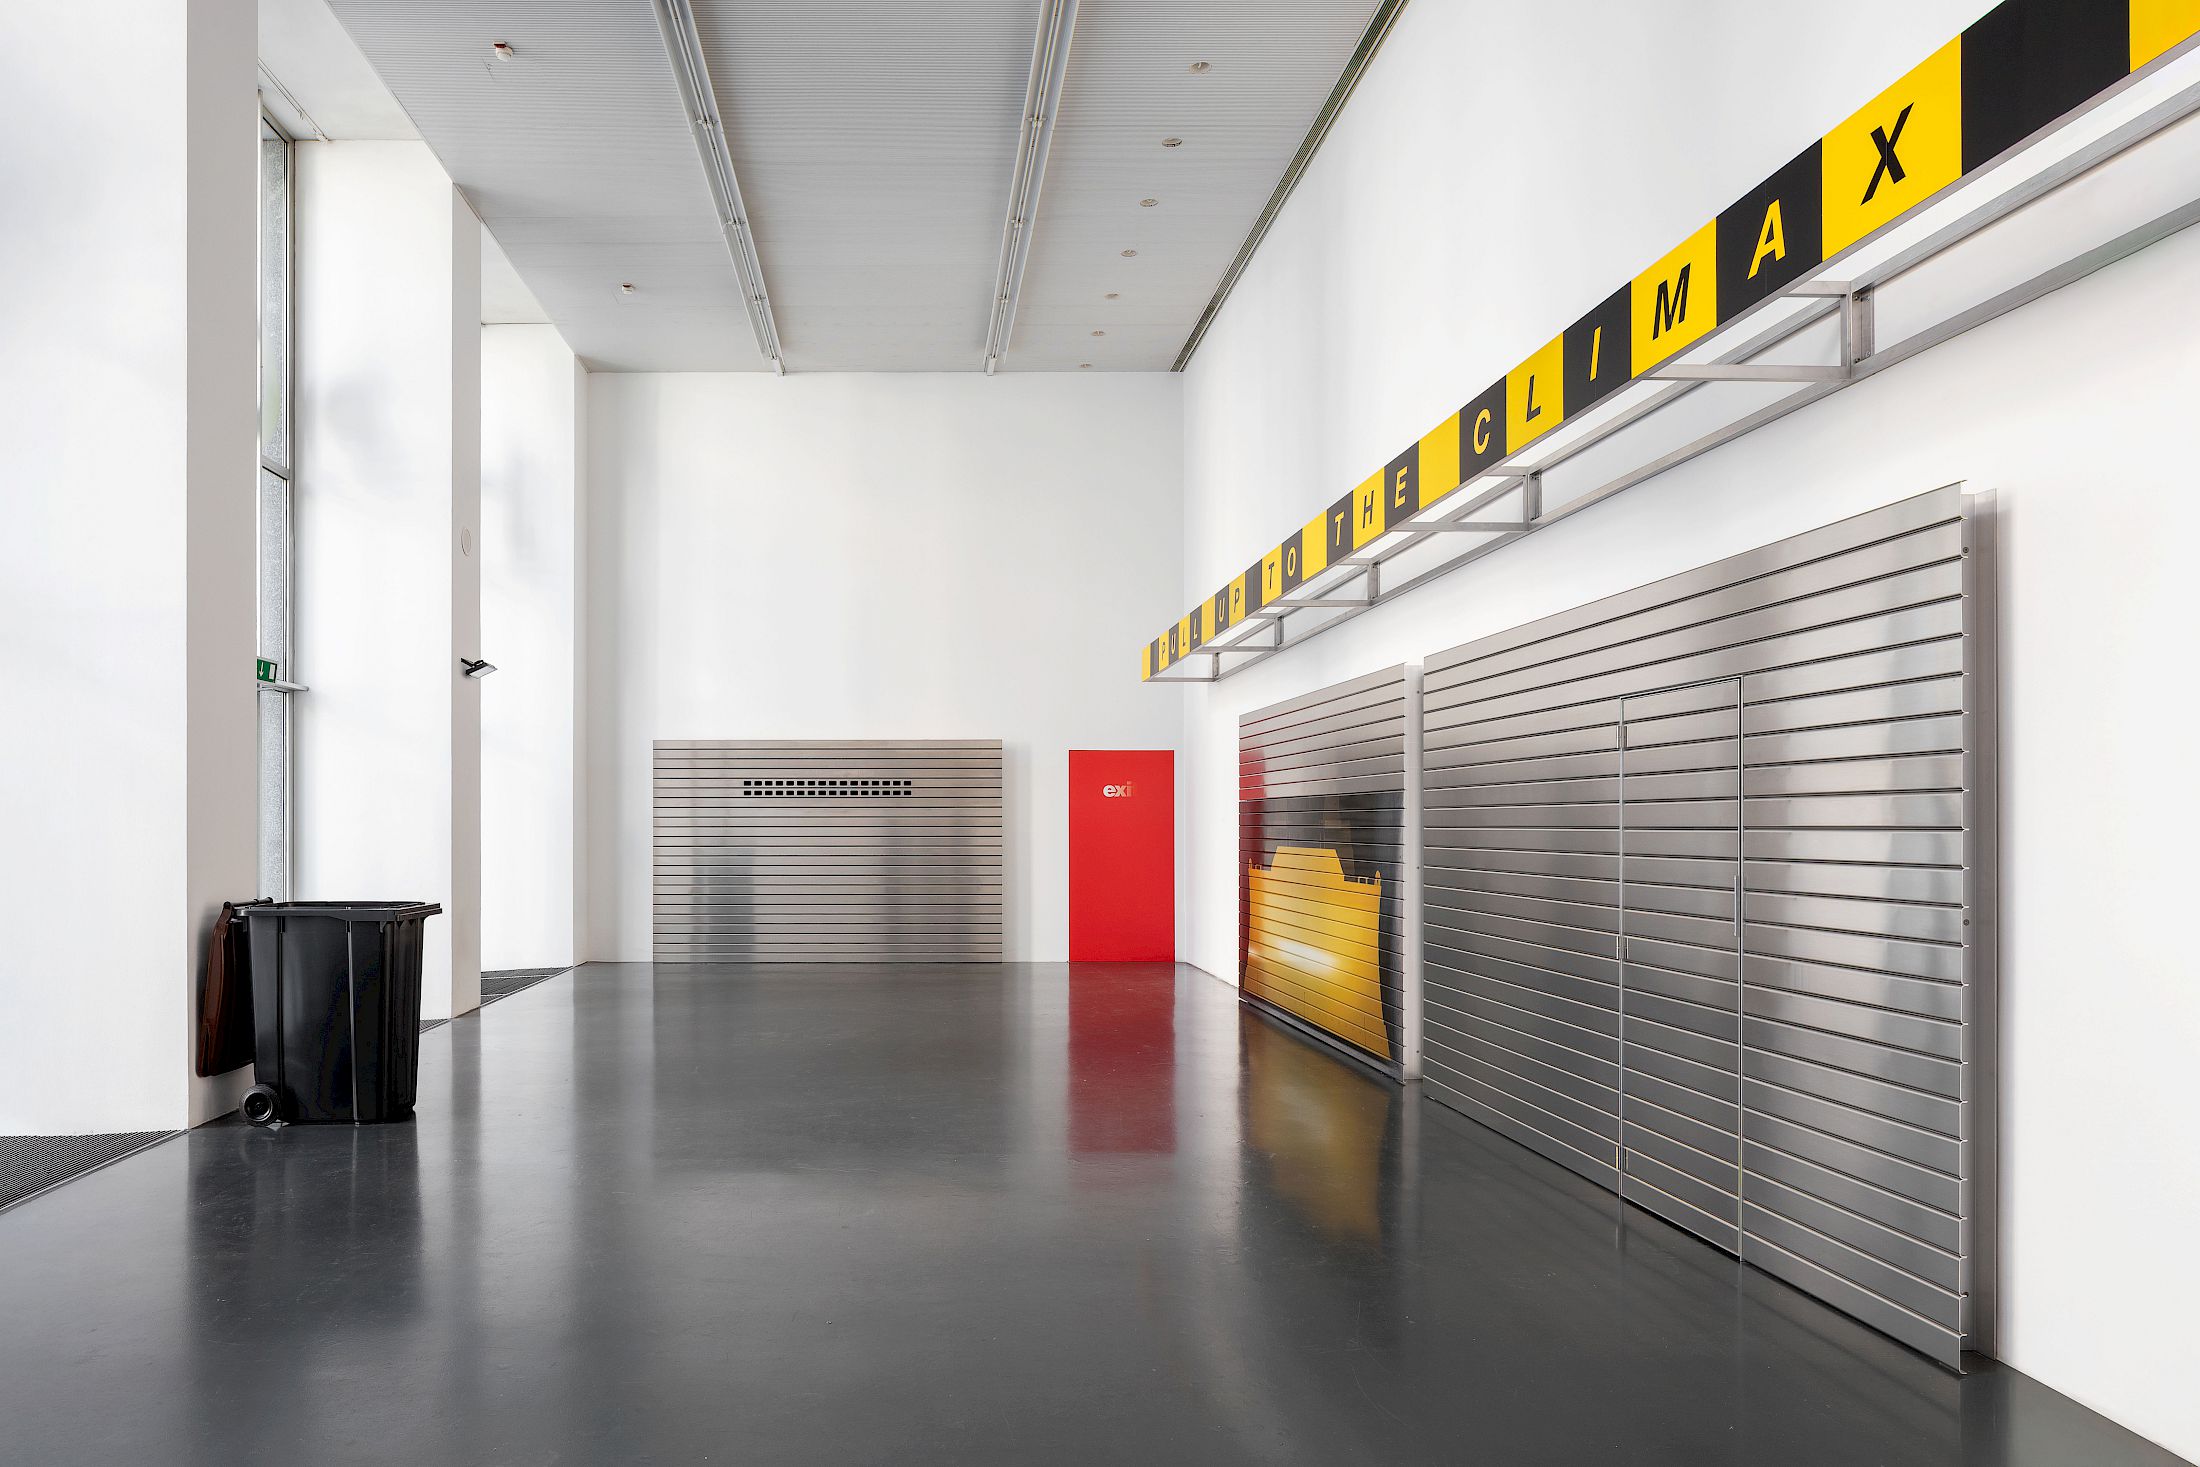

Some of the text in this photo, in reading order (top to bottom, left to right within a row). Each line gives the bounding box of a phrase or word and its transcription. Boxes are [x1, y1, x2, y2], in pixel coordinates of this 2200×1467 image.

[1161, 102, 1915, 660] PULL UP TO THE CLIMAX
